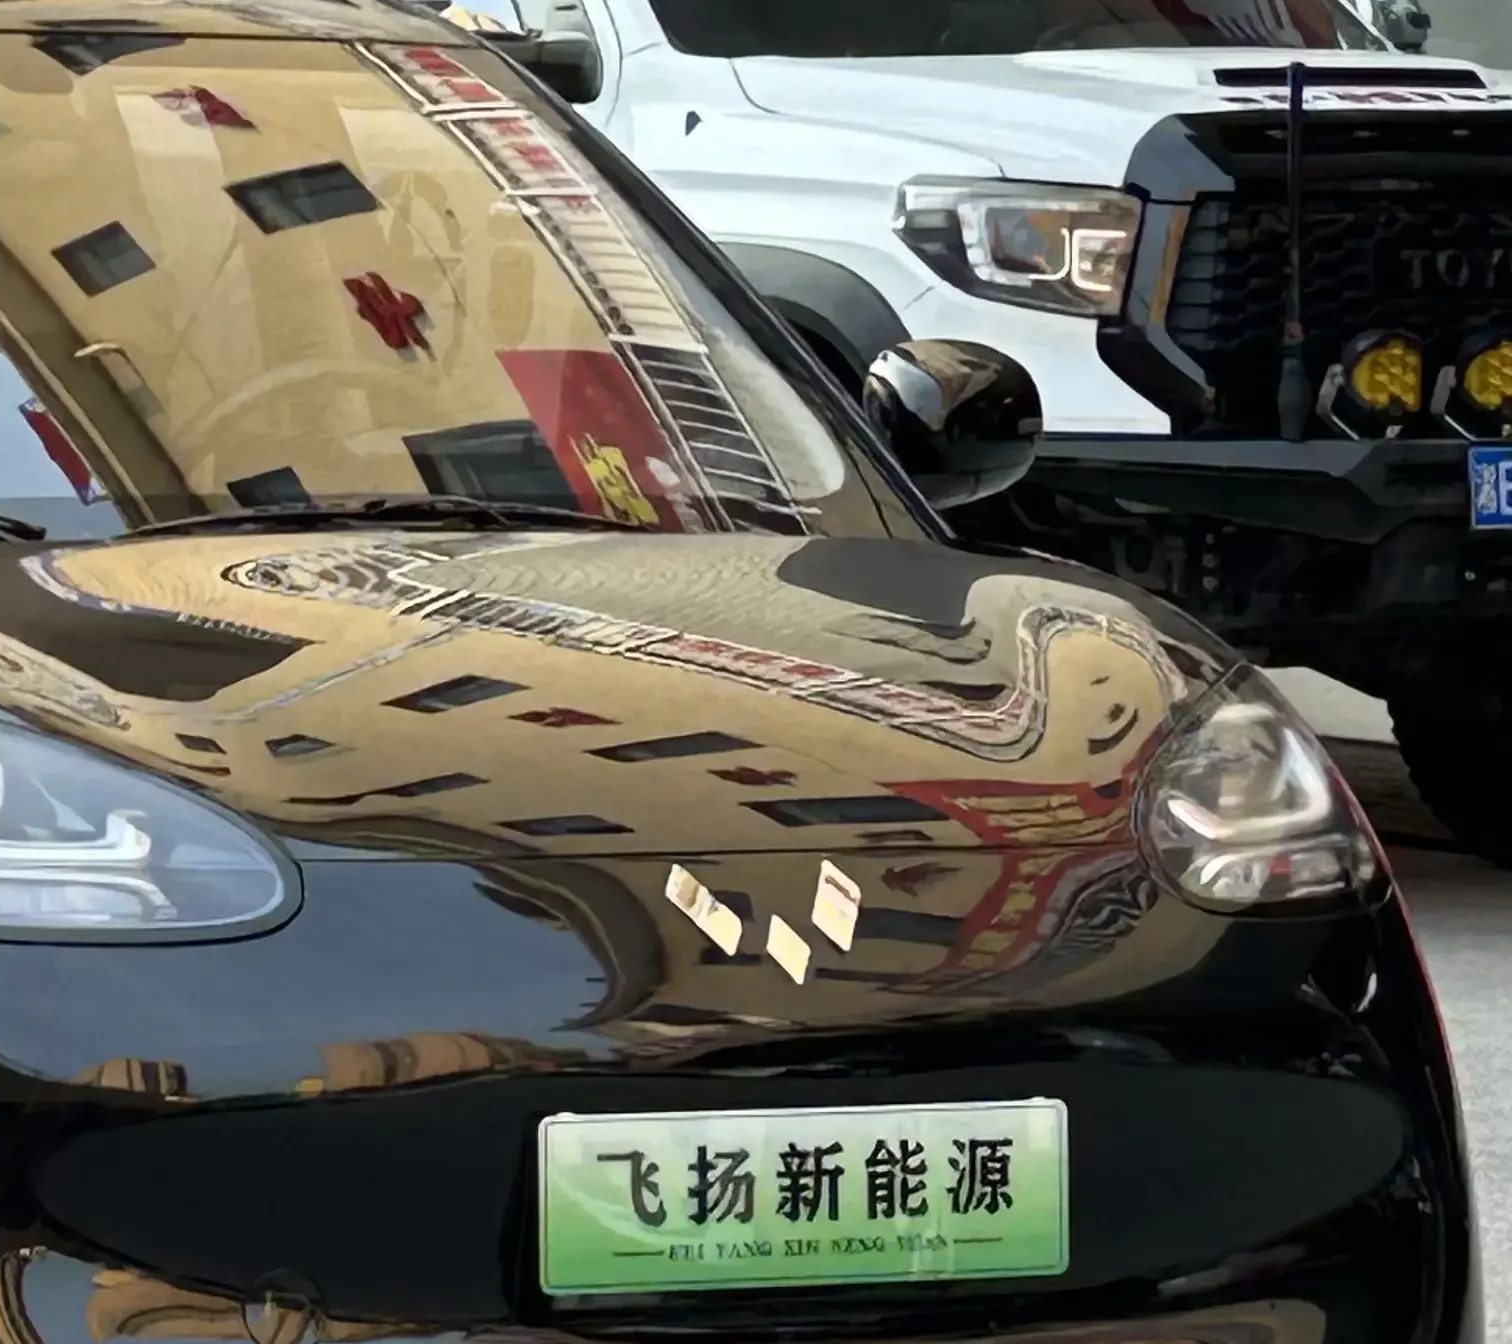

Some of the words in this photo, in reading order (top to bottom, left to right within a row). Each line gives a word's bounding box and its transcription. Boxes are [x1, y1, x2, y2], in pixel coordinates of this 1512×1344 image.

[597, 1137, 1014, 1227] 飞扬新能源
